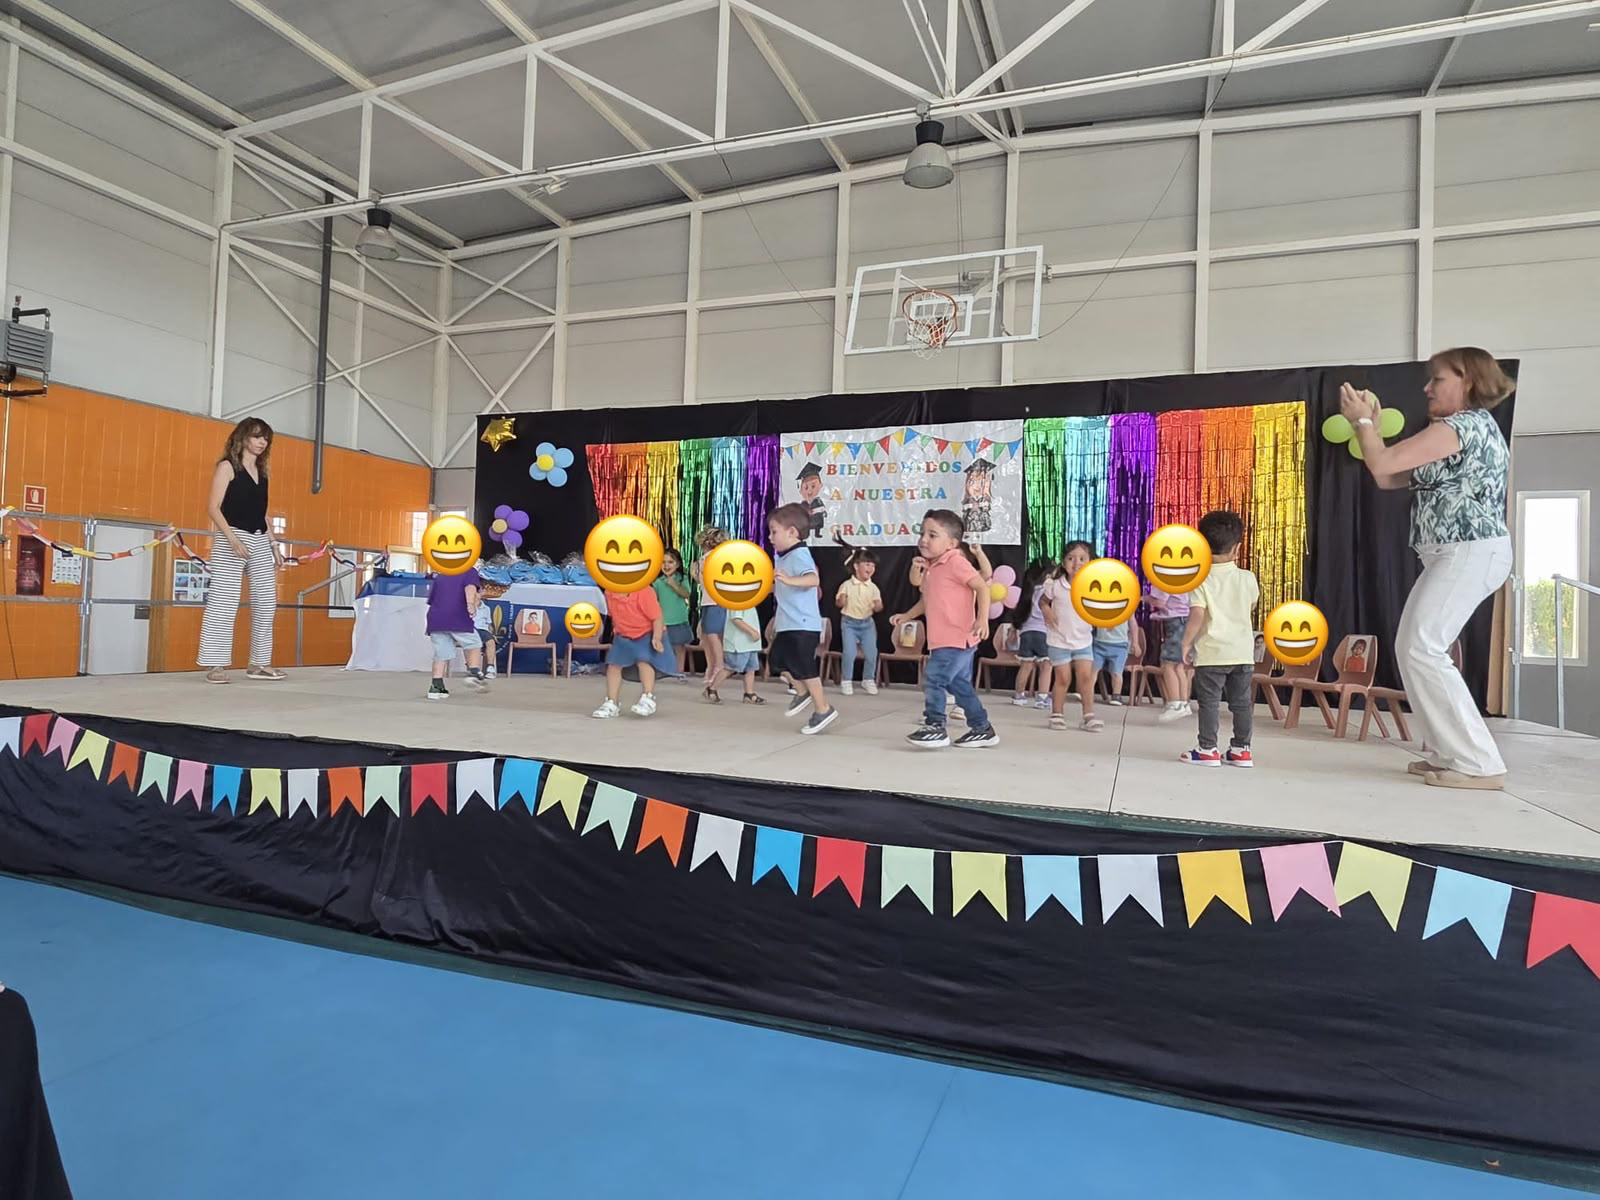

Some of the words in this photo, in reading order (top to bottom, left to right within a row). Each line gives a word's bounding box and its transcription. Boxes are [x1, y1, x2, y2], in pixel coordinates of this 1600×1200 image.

[830, 488, 842, 500] A
[854, 487, 947, 500] NUESTRA
[831, 523, 922, 536] GRADUAC
